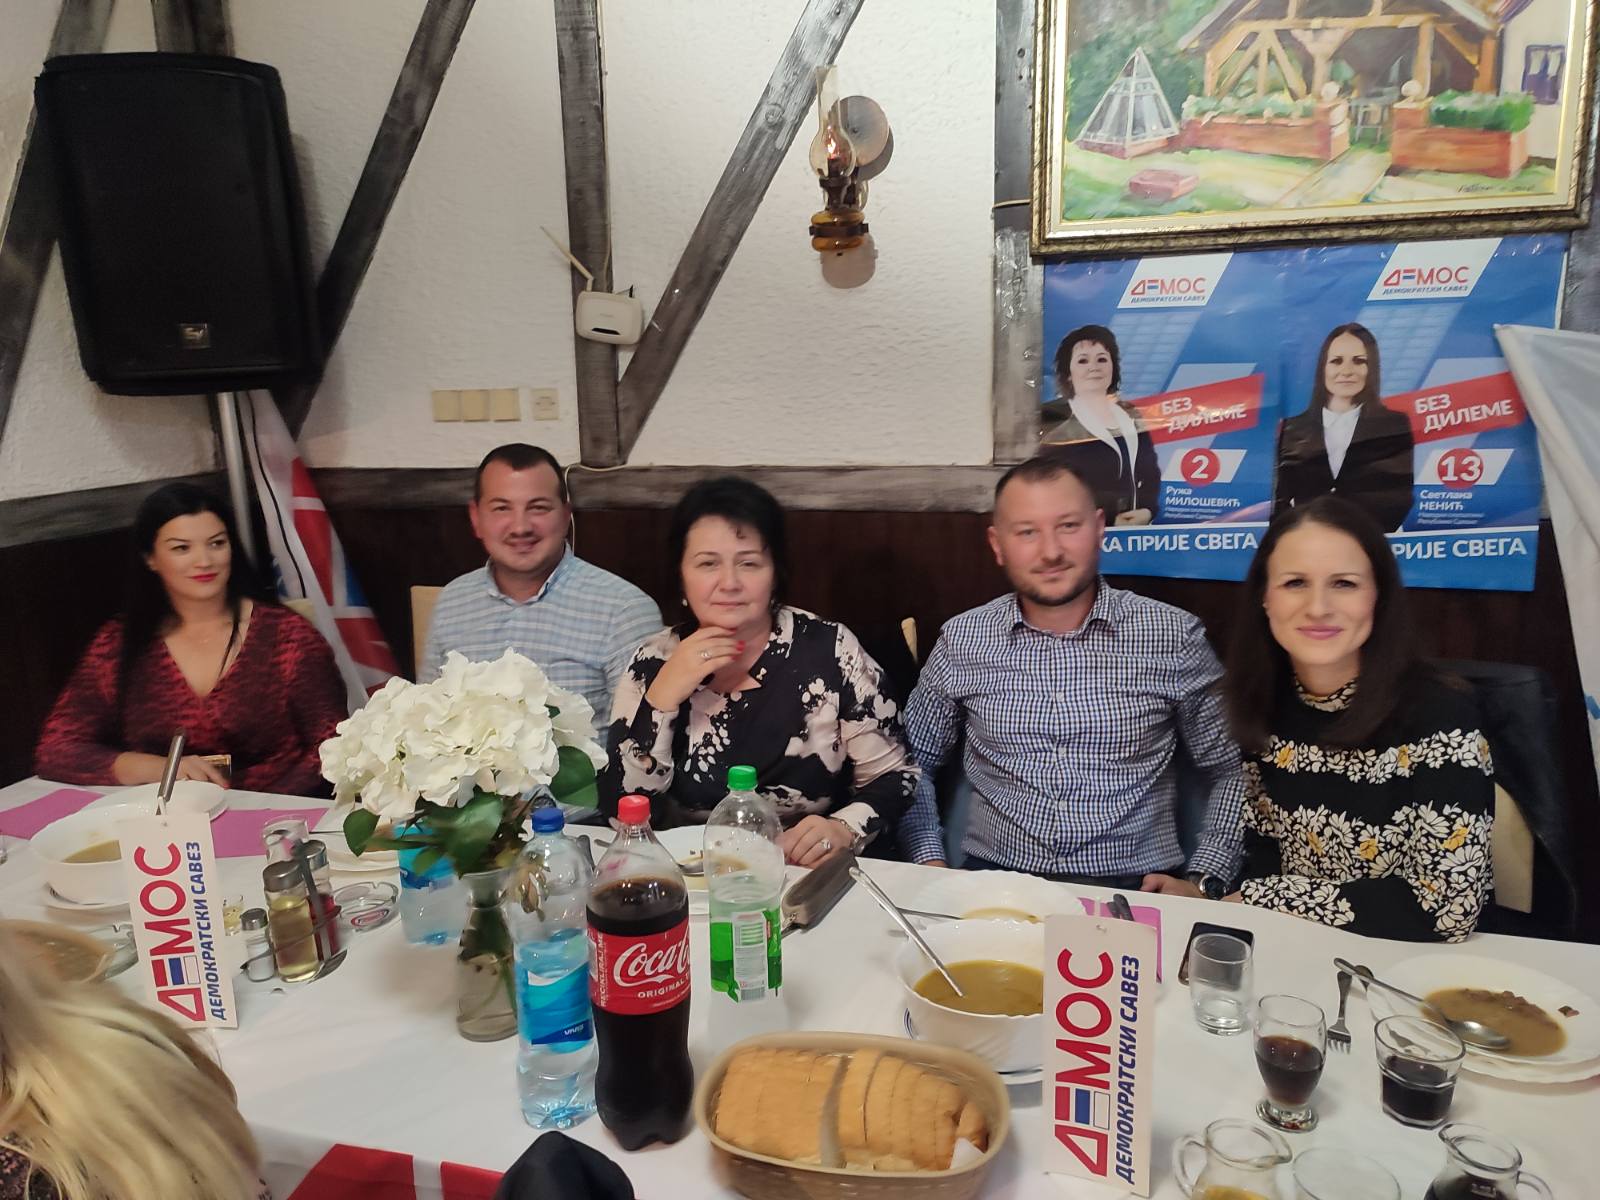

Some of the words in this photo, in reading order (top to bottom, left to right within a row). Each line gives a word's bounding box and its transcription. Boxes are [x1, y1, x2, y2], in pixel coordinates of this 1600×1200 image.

[1162, 396, 1193, 415] БЕЗ
[1415, 393, 1451, 414] БЕЗ
[1167, 403, 1248, 434] ДИЛЕМЕ
[1423, 399, 1514, 434] ДИЛЕМЕ
[1190, 454, 1210, 479] 2
[1441, 455, 1482, 482] 13
[1165, 486, 1193, 497] Ружа
[1165, 496, 1241, 508] МИЛОШЕВИЋ
[1419, 489, 1473, 500] Светлана
[1418, 500, 1464, 511] НЕНИЋ
[1127, 533, 1191, 552] ПРИЈЕ
[1194, 531, 1260, 551] СВЕГА
[1391, 540, 1447, 560] РИЈЕ
[1452, 537, 1528, 558] СВЕГА
[186, 842, 206, 895] САВЕЗ
[193, 899, 228, 1021] ДЕМОКРАТСКИ
[637, 978, 685, 998] ORIGINAL
[1120, 955, 1140, 1023] САВЕЗ
[1115, 1024, 1137, 1186] ДЕМОКРАТСКИ
